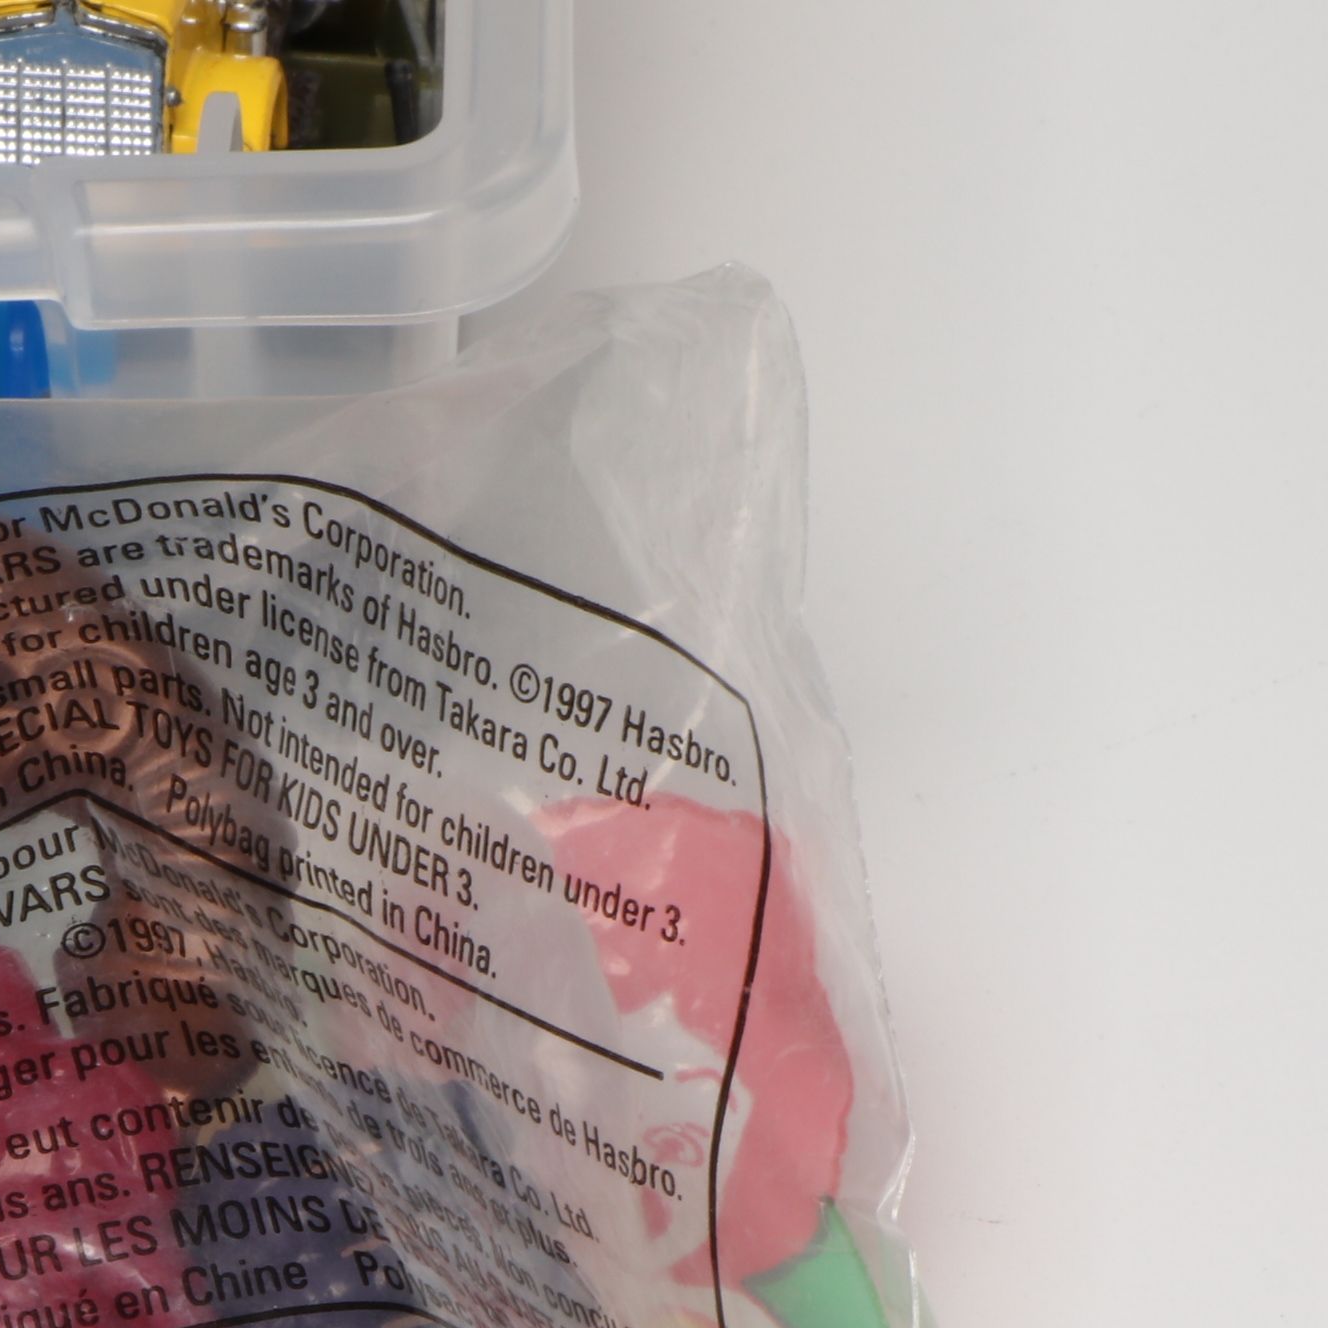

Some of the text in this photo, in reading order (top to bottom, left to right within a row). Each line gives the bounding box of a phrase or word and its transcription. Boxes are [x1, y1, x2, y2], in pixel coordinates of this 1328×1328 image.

[40, 490, 290, 533] McDonald's
[303, 501, 470, 620] Corporation.
[1, 628, 63, 662] for
[78, 608, 232, 669] children
[245, 644, 295, 696] age
[302, 670, 320, 709] 3
[326, 689, 373, 743] and
[380, 731, 443, 779] over.
[77, 541, 144, 568] are
[157, 533, 353, 614] trademarks
[364, 596, 390, 630] of
[397, 609, 498, 693] Hasbro.
[509, 662, 612, 734] ©1997
[622, 709, 737, 788] Hasbro.
[141, 573, 250, 619] under
[262, 590, 359, 673] license
[367, 648, 426, 713] from
[437, 683, 528, 762] Takara
[538, 737, 584, 786] Co.
[597, 755, 651, 811] Ltd.
[17, 745, 134, 794] China.
[164, 772, 270, 873] Polybag
[280, 851, 373, 917] printed
[382, 889, 407, 932] in
[415, 906, 497, 980] China.
[113, 663, 211, 717] parts.
[222, 692, 273, 745] Not
[279, 719, 387, 813] intended
[397, 784, 434, 835] for
[441, 807, 554, 894] children
[564, 873, 655, 935] under
[660, 906, 686, 947] 3.
[125, 701, 213, 768] TOYS
[220, 746, 272, 804] FOR
[277, 777, 341, 842] KIDS
[347, 820, 451, 899] UNDER
[455, 869, 480, 912] 3.
[35, 969, 220, 1026] Fabriqué
[268, 906, 436, 1021] Corporation.
[70, 1027, 170, 1082] pour
[181, 1021, 241, 1058] les
[91, 1089, 264, 1140] contenir
[249, 942, 373, 1017] marques
[377, 1000, 404, 1042] de
[410, 1032, 541, 1125] commerce
[550, 1103, 577, 1147] de
[583, 1120, 684, 1202] Hasbro.
[42, 1171, 130, 1211] ans.
[73, 1216, 158, 1267] LES
[171, 1195, 331, 1248] MOINS
[115, 1285, 169, 1320] en
